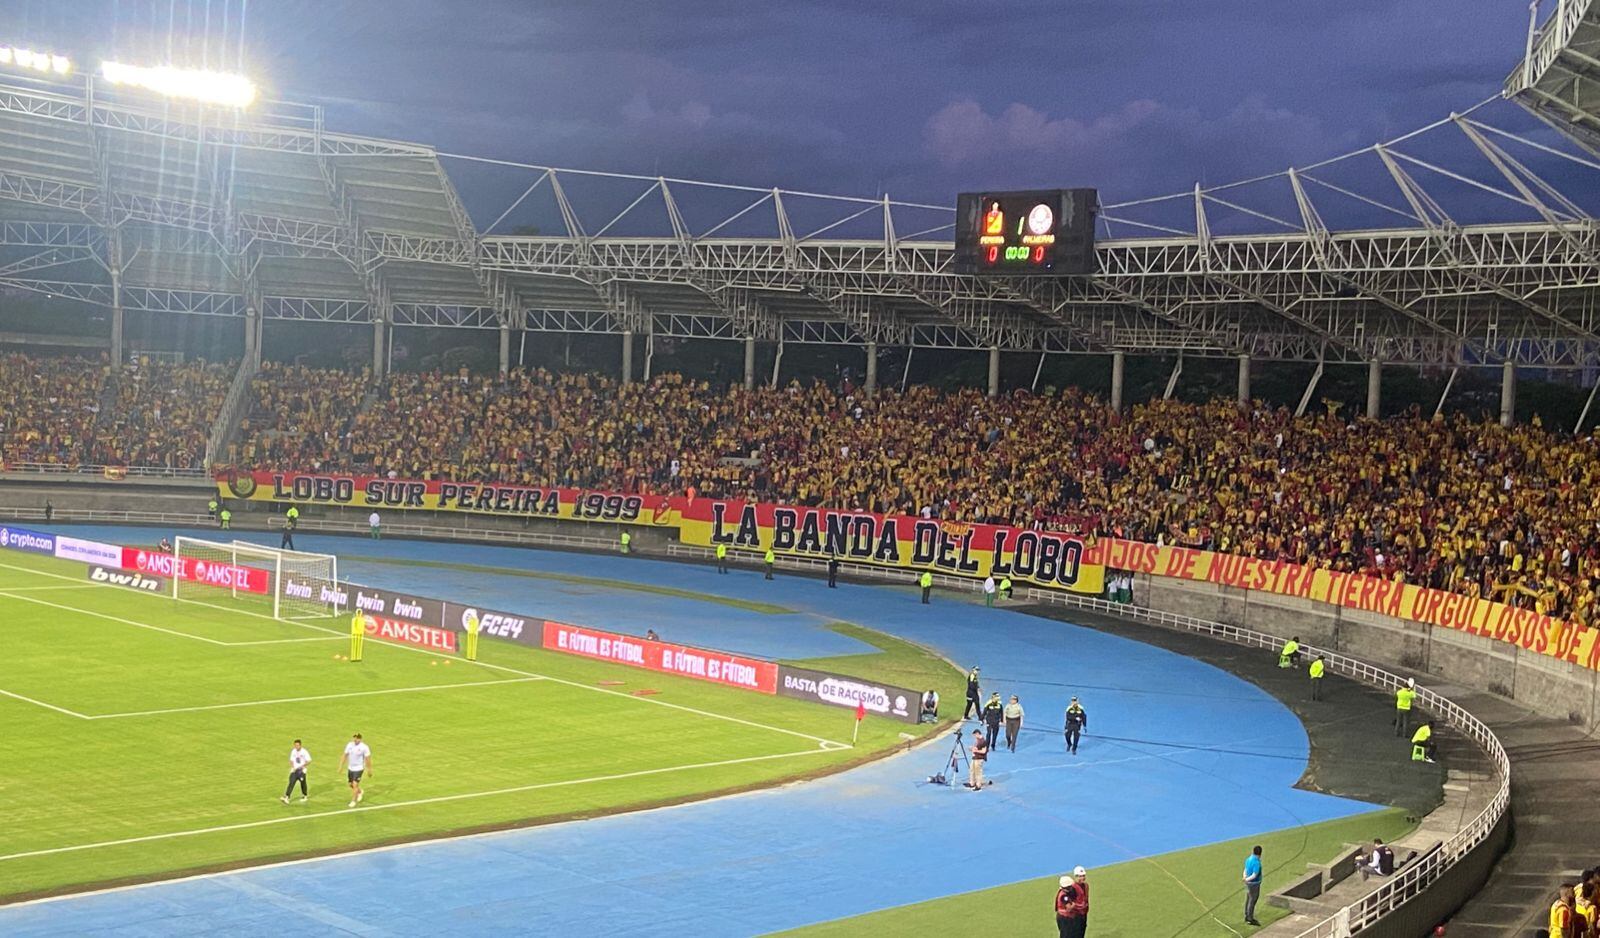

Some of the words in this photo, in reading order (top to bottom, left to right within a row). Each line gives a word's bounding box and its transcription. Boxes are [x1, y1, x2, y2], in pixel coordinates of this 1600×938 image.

[989, 246, 998, 262] 0
[1035, 246, 1044, 262] 0
[272, 474, 355, 503] LOBO
[364, 480, 427, 507] SUR
[437, 483, 561, 517] PEREIRA
[571, 491, 643, 522] 1999
[10, 533, 53, 550] crypto.com
[711, 502, 760, 548] LA
[772, 507, 900, 564] BANDA
[911, 520, 980, 574] DEL
[991, 529, 1084, 587] LOBO
[147, 553, 188, 577] AMSTEL
[206, 563, 250, 589] AMSTEL
[91, 567, 158, 591] bwin
[286, 579, 312, 598] bwin
[320, 585, 348, 605] bwin
[355, 591, 385, 612] bwin
[1164, 547, 1201, 578] DE
[1206, 553, 1313, 599] NUESTRA
[1325, 570, 1404, 617] TIERRA
[1411, 588, 1551, 654] ORGULLOSOS
[1554, 622, 1589, 664] DE
[393, 598, 423, 619] bwin
[381, 620, 453, 650] AMSTEL
[479, 613, 525, 639] FC24
[558, 630, 567, 648] EL
[600, 638, 611, 657] ES
[612, 636, 645, 664] FÚTBOL
[662, 649, 673, 668] EL
[708, 659, 720, 678] ES
[722, 656, 758, 687] FÚTBOL
[784, 675, 817, 694] BASTA
[822, 684, 836, 696] DE
[837, 686, 884, 707] RACISMO
